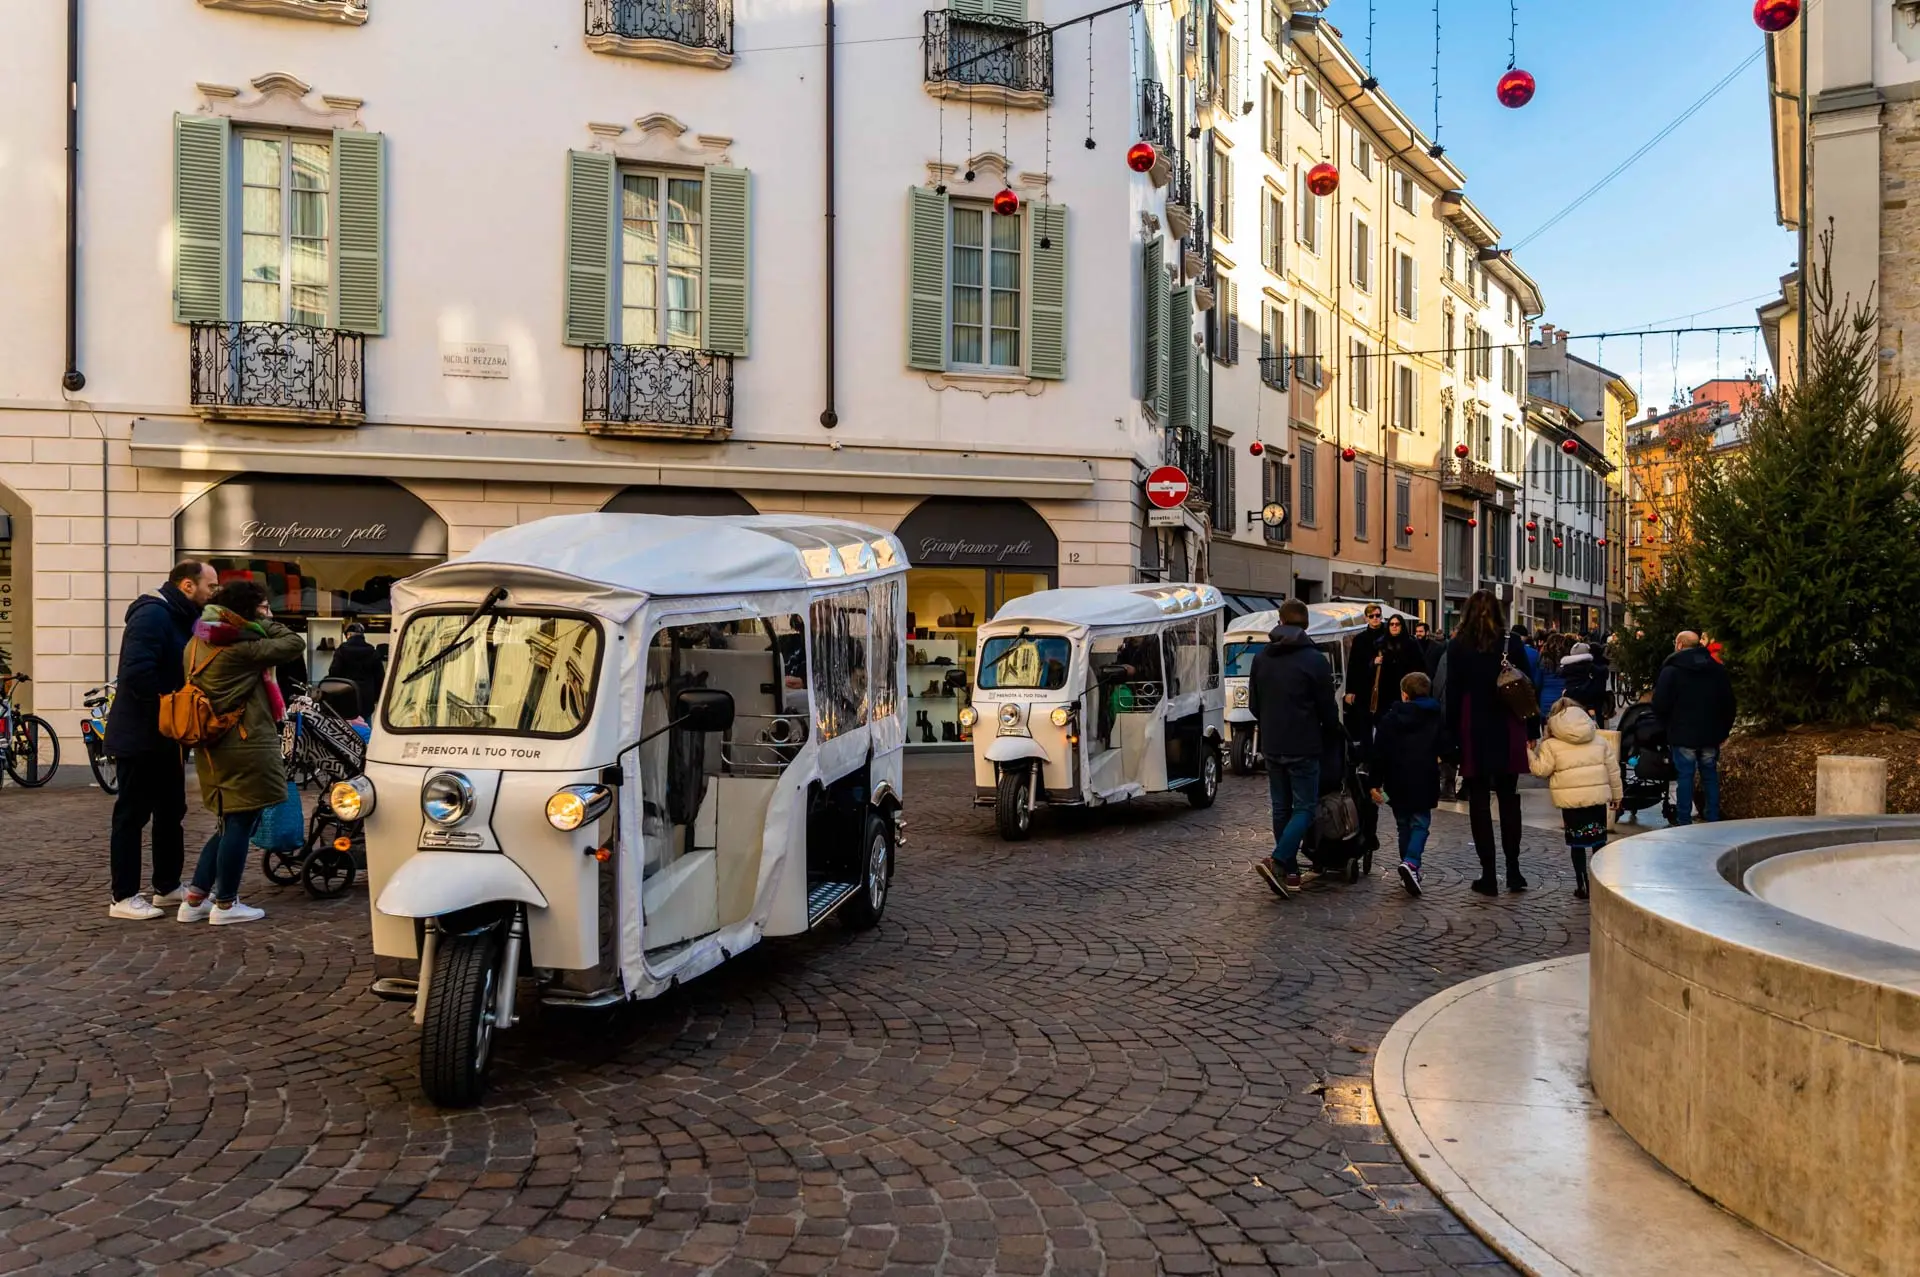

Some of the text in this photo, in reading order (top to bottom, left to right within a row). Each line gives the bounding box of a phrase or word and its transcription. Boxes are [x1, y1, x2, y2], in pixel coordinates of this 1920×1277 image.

[473, 356, 507, 366] REZZARA
[239, 520, 388, 548] Gianfranco pelle
[919, 537, 1033, 561] Gianfranco pelle
[1068, 552, 1080, 563] 12
[421, 746, 541, 759] PRENOTA IL TUO TOUR
